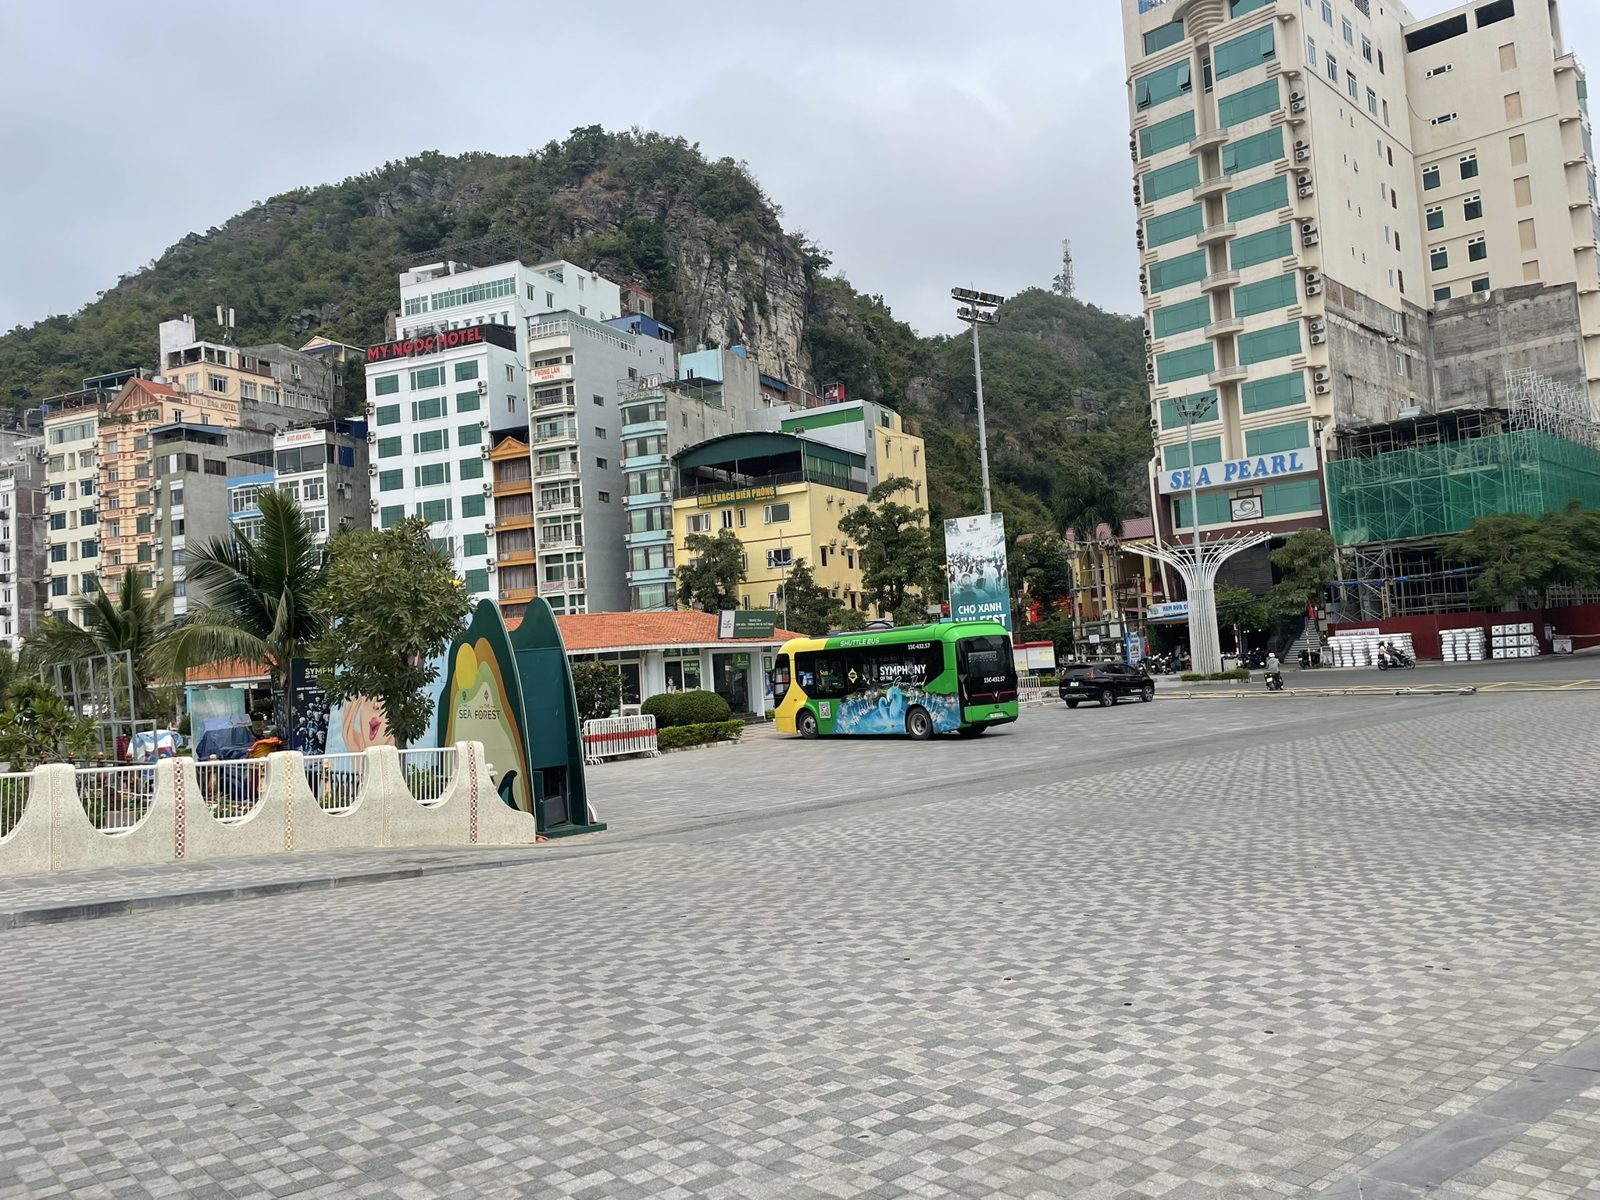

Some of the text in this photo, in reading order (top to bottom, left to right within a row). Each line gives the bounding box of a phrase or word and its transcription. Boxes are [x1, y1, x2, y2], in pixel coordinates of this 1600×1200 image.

[437, 327, 483, 349] HOTEL
[1170, 452, 1303, 489] SEA PEARL
[958, 602, 1002, 615] CHỢ XANH
[879, 664, 927, 676] SYMPHONY
[459, 709, 501, 720] SEA FOREST
